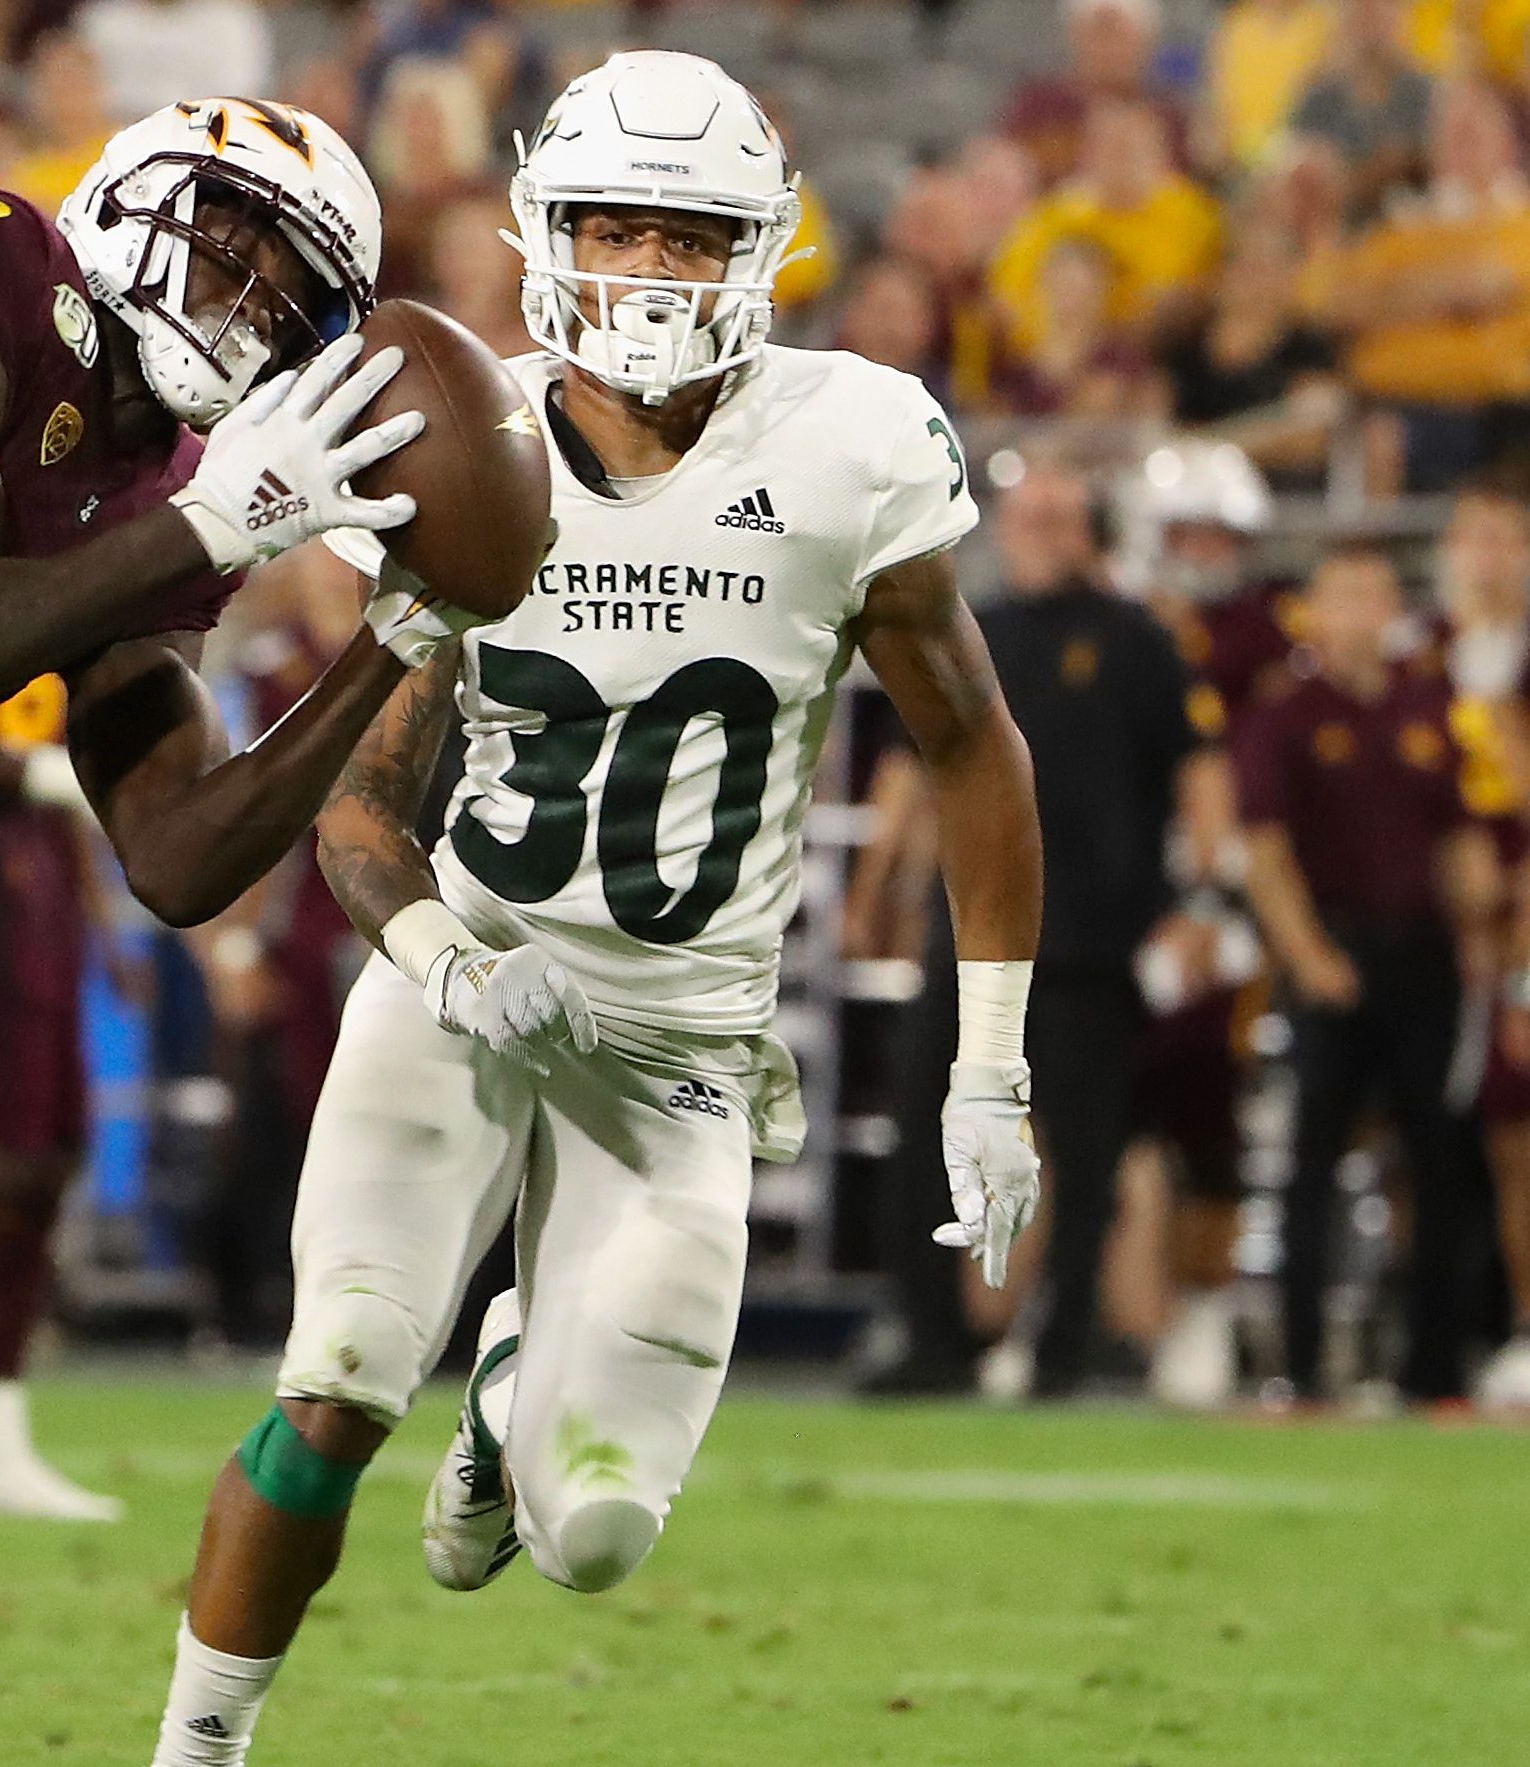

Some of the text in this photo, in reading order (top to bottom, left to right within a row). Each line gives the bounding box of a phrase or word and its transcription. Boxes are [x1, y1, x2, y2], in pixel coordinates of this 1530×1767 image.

[631, 161, 690, 174] HORNETS
[247, 496, 309, 531] adidas
[715, 512, 785, 535] adidas
[528, 563, 765, 604] CRAMENTO
[562, 600, 686, 633] STATE
[449, 640, 779, 944] 30
